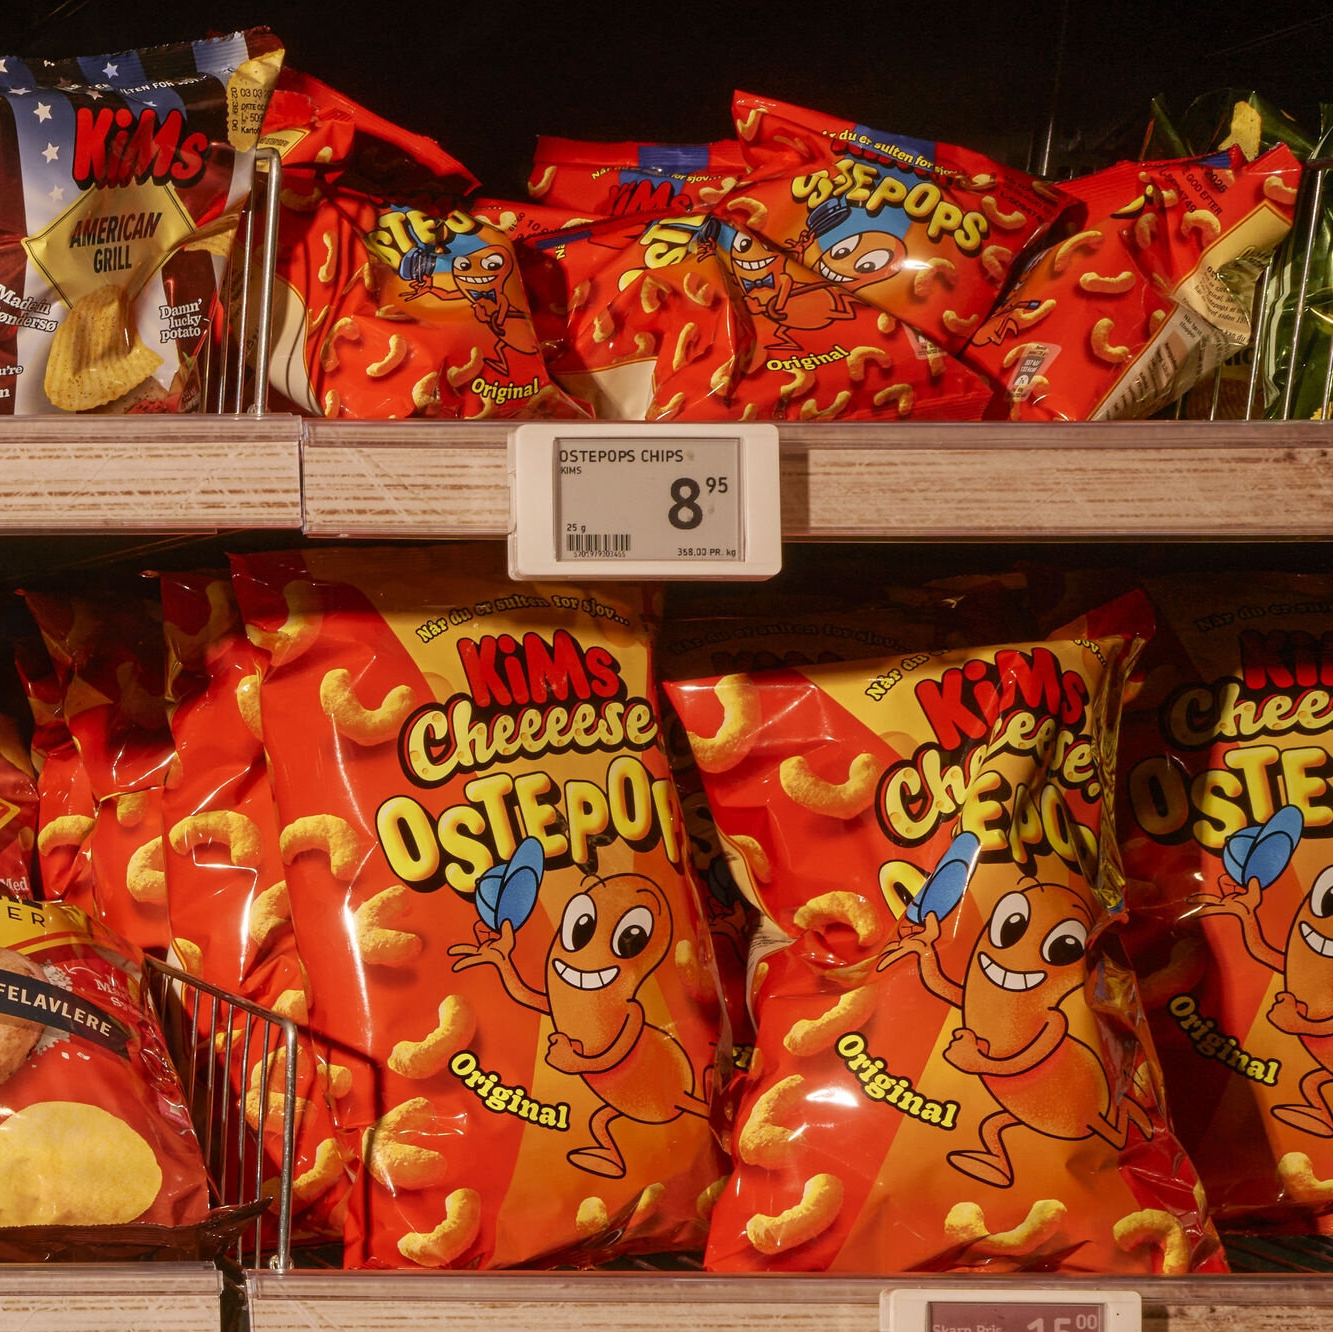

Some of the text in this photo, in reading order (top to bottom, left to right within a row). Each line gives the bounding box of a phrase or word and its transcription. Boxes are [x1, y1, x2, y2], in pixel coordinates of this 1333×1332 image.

[73, 108, 208, 182] KiMs
[69, 213, 162, 248] AMERICAN
[94, 250, 132, 273] GRILL
[160, 326, 201, 344] potato
[766, 347, 850, 373] Original
[472, 378, 539, 402] Original
[559, 450, 683, 462] OSTEPOPS CHIPS
[668, 478, 728, 529] 8 95
[457, 630, 621, 706] KiMs
[1165, 991, 1281, 1090] Original
[449, 1052, 570, 1132] Original
[837, 1031, 959, 1130] Original
[1076, 1314, 1097, 1330] 00
